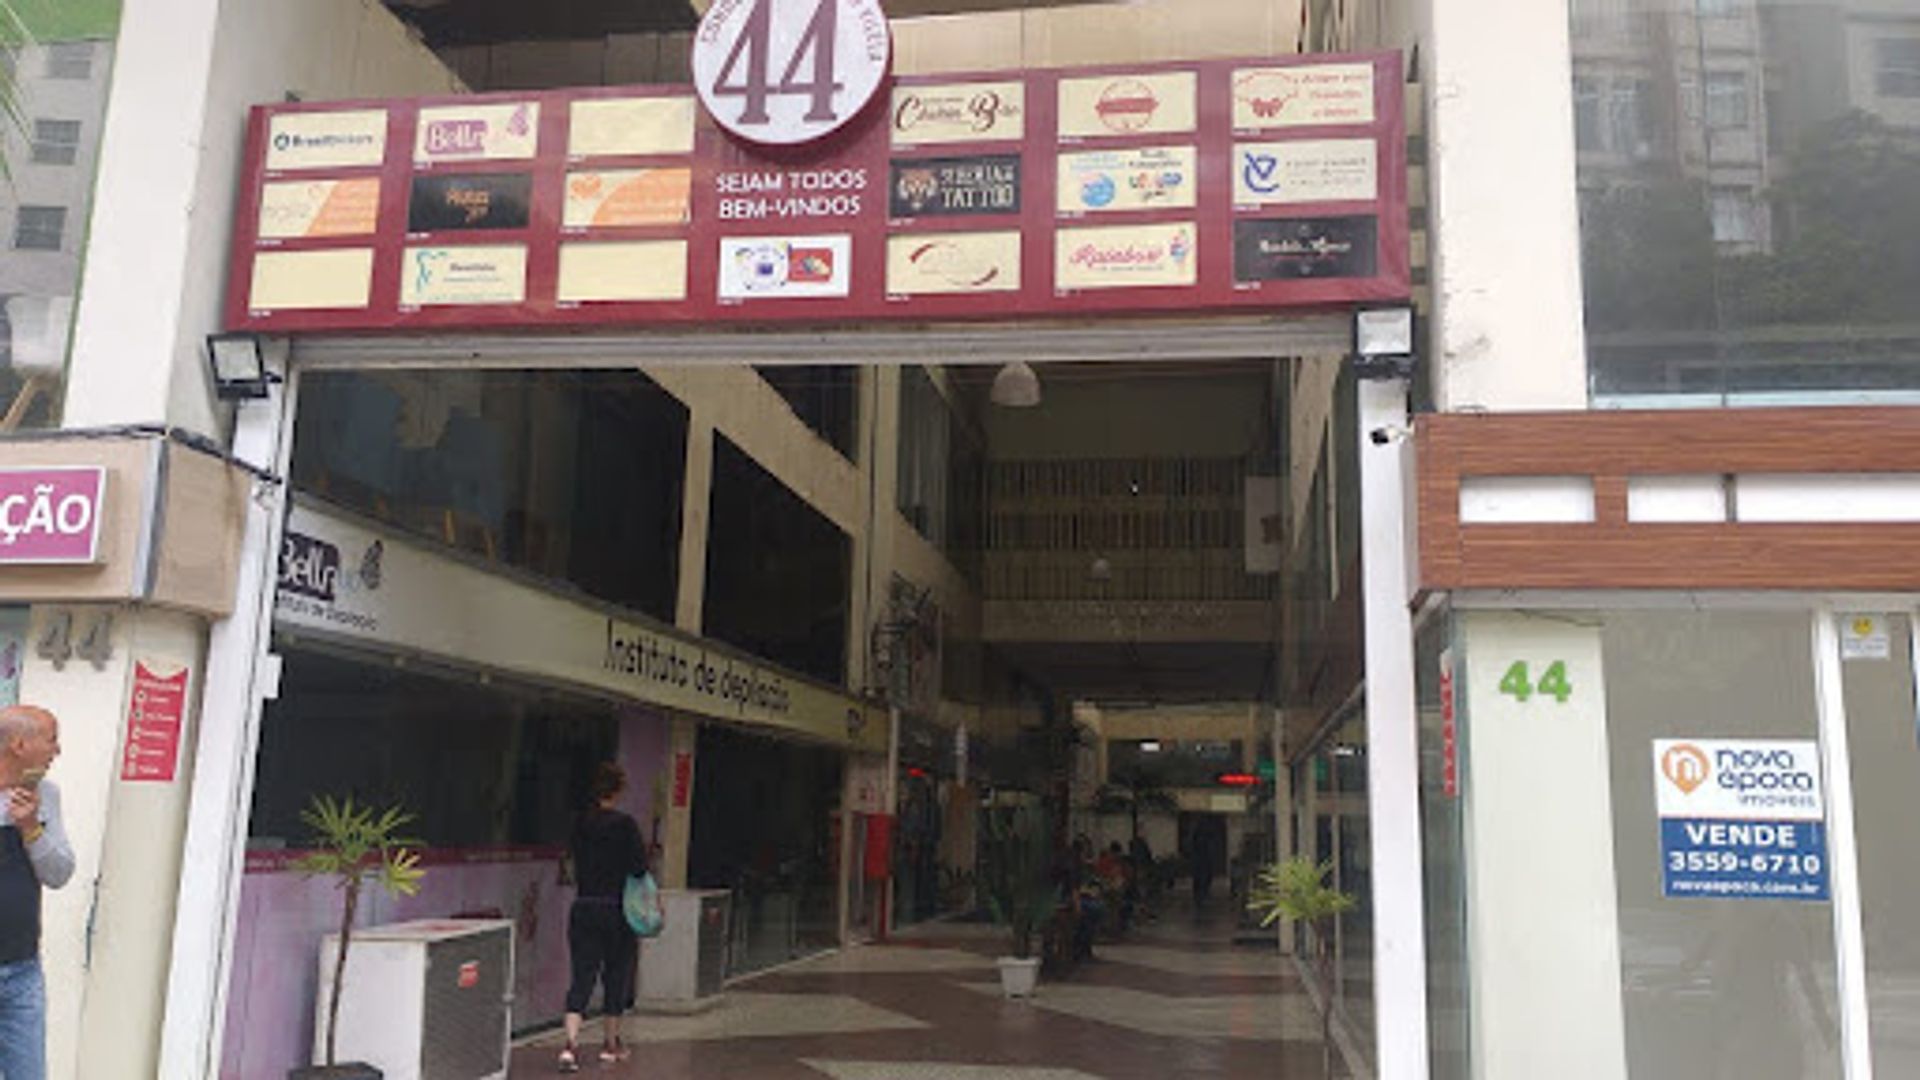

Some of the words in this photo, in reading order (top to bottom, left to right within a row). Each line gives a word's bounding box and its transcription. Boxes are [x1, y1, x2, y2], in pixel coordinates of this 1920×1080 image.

[713, 0, 844, 125] 44
[717, 173, 782, 192] SEJAM
[790, 169, 867, 190] TODOS
[718, 197, 861, 219] BEM-VINDOS
[37, 612, 114, 671] 44
[602, 618, 687, 688] Instituto
[694, 650, 715, 696] de
[1500, 660, 1572, 702] 44
[1717, 750, 1794, 770] nova
[1685, 824, 1797, 847] VENDE
[1669, 851, 1821, 875] 3559-6710
